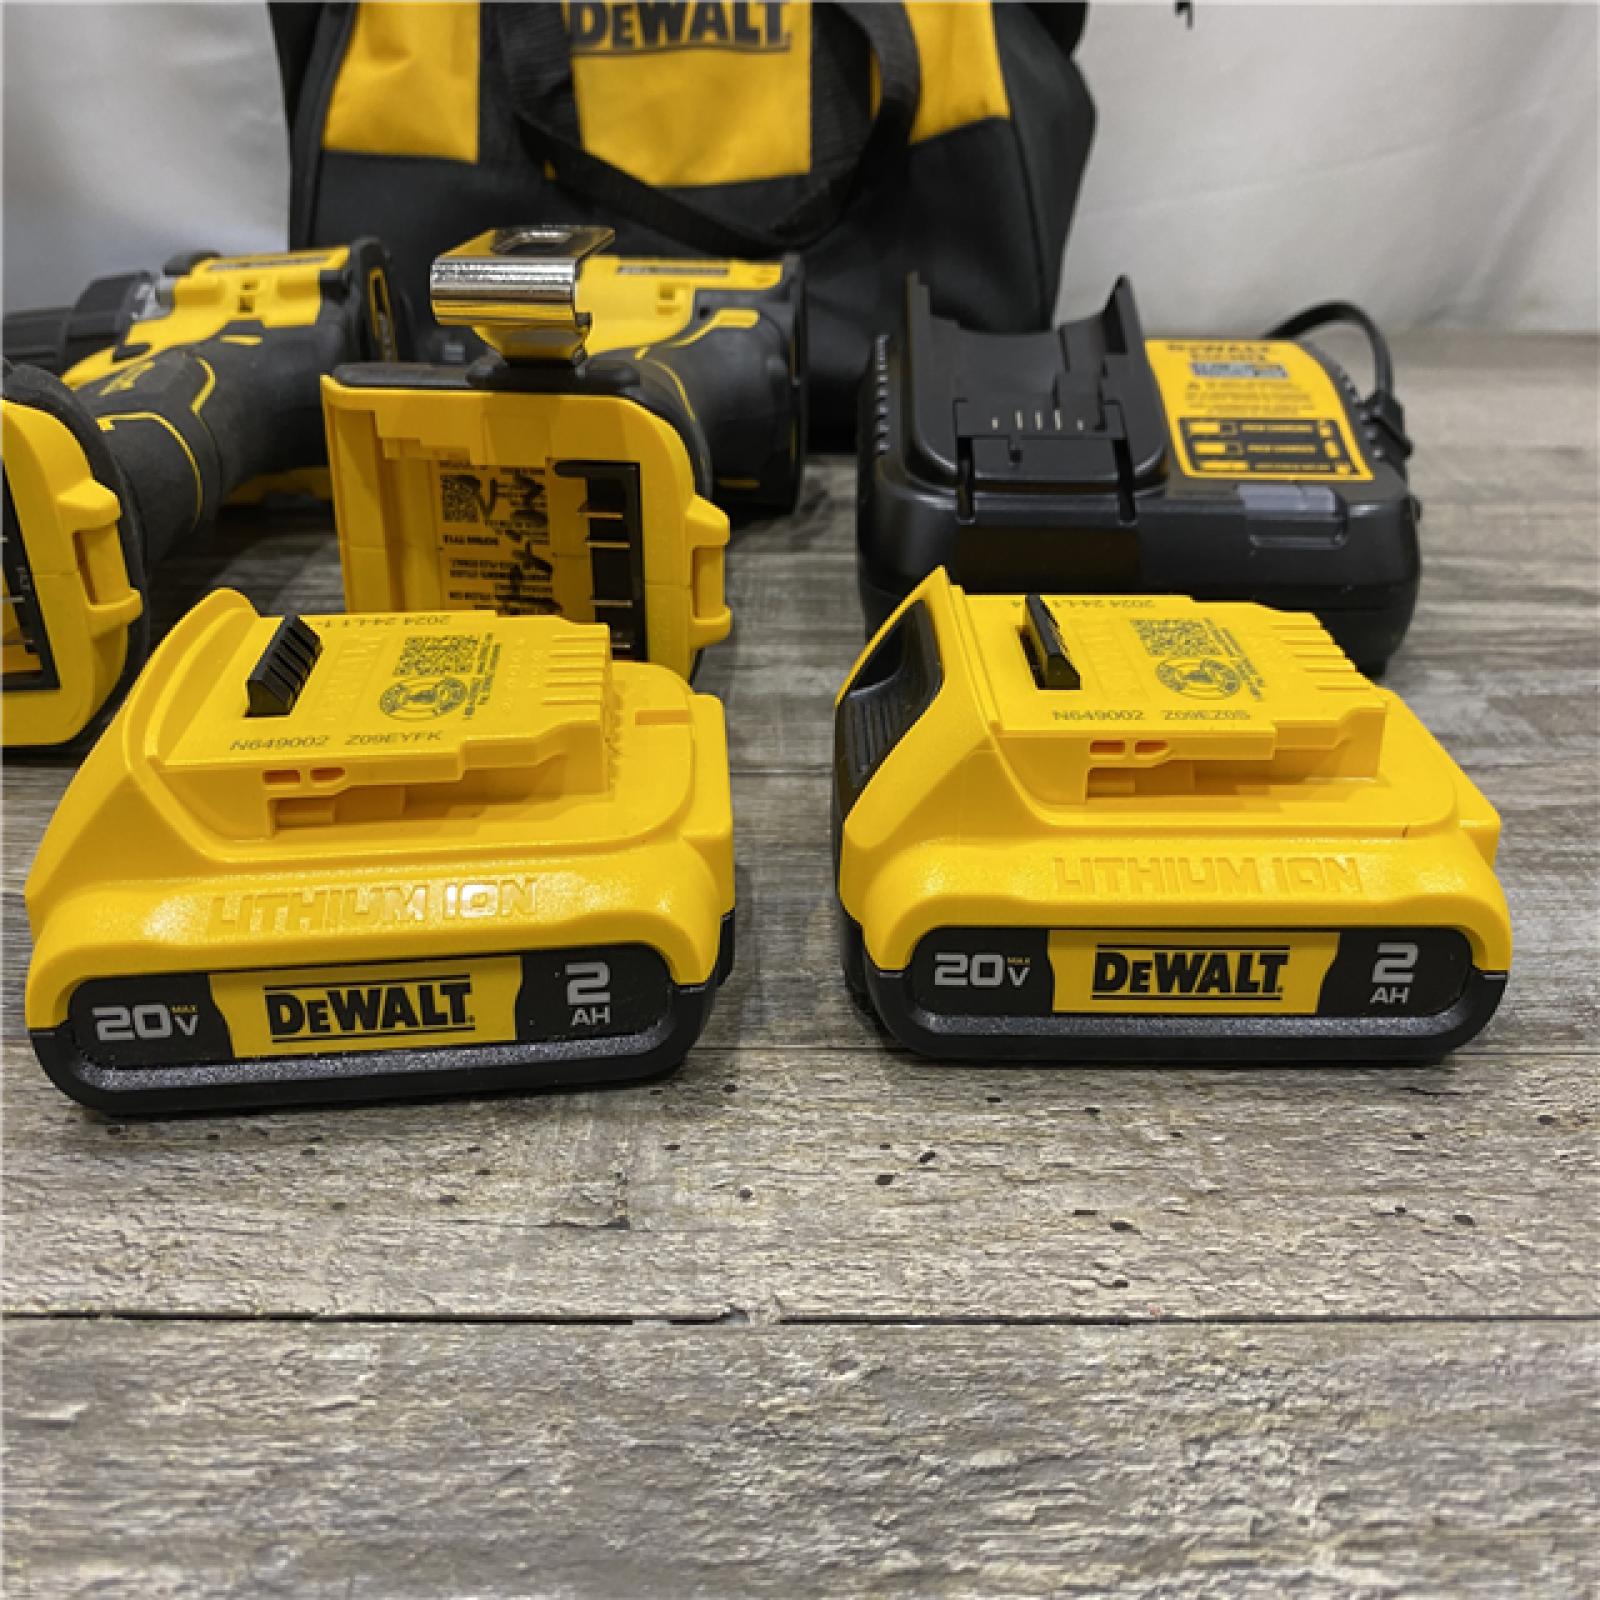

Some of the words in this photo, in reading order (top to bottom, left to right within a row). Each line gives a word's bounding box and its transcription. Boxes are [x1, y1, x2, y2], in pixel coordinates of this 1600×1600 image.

[568, 2, 791, 50] DEWALT
[229, 734, 331, 752] N649002
[1053, 856, 1261, 895] LITHIUM
[1272, 856, 1364, 894] ION
[206, 883, 428, 935] LITHIUM
[442, 878, 539, 919] ION
[565, 961, 610, 1004] 2
[1093, 951, 1287, 995] DEWALT
[1372, 942, 1418, 984] 2
[264, 982, 476, 1036] DEWALT
[1370, 986, 1410, 1004] AH
[570, 1007, 611, 1027] AH
